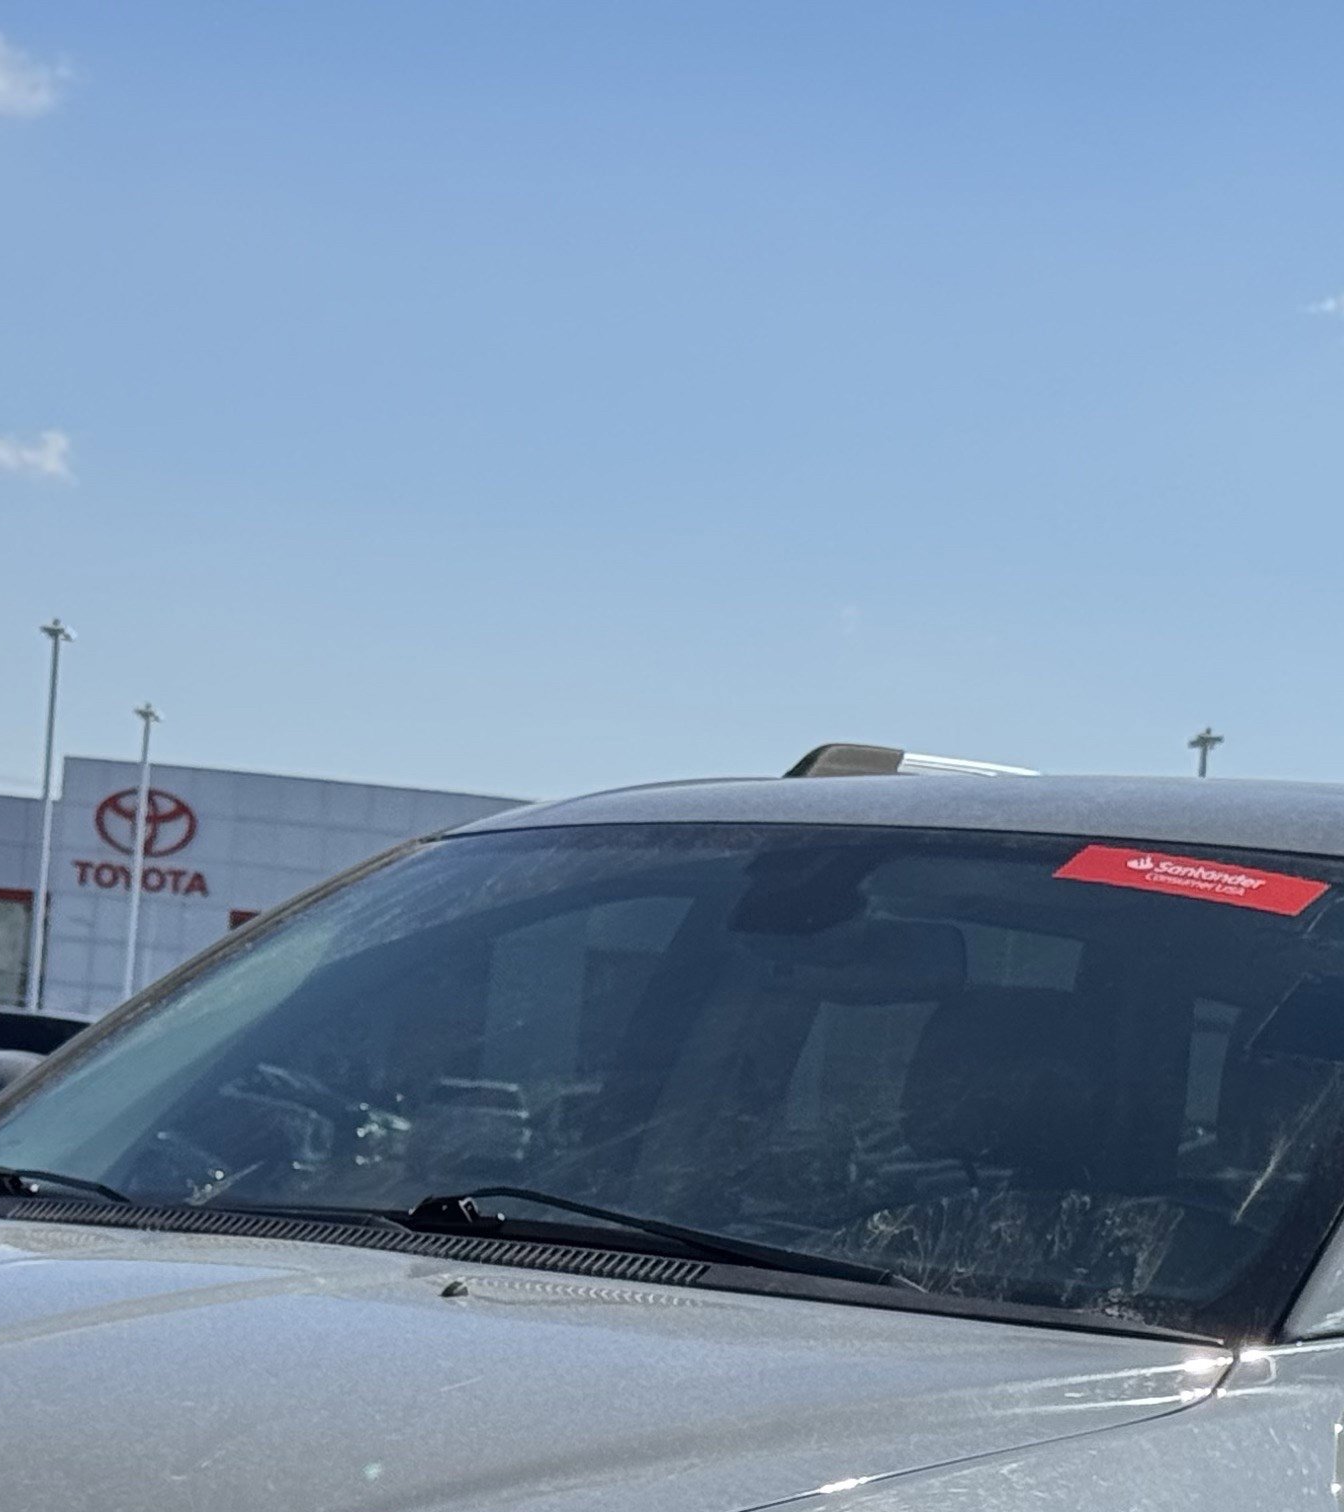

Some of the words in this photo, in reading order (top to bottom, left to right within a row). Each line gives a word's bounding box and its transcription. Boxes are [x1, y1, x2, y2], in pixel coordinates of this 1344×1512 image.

[72, 860, 209, 898] TOYOTA
[1153, 860, 1266, 890] Santander
[1215, 883, 1246, 897] USA
